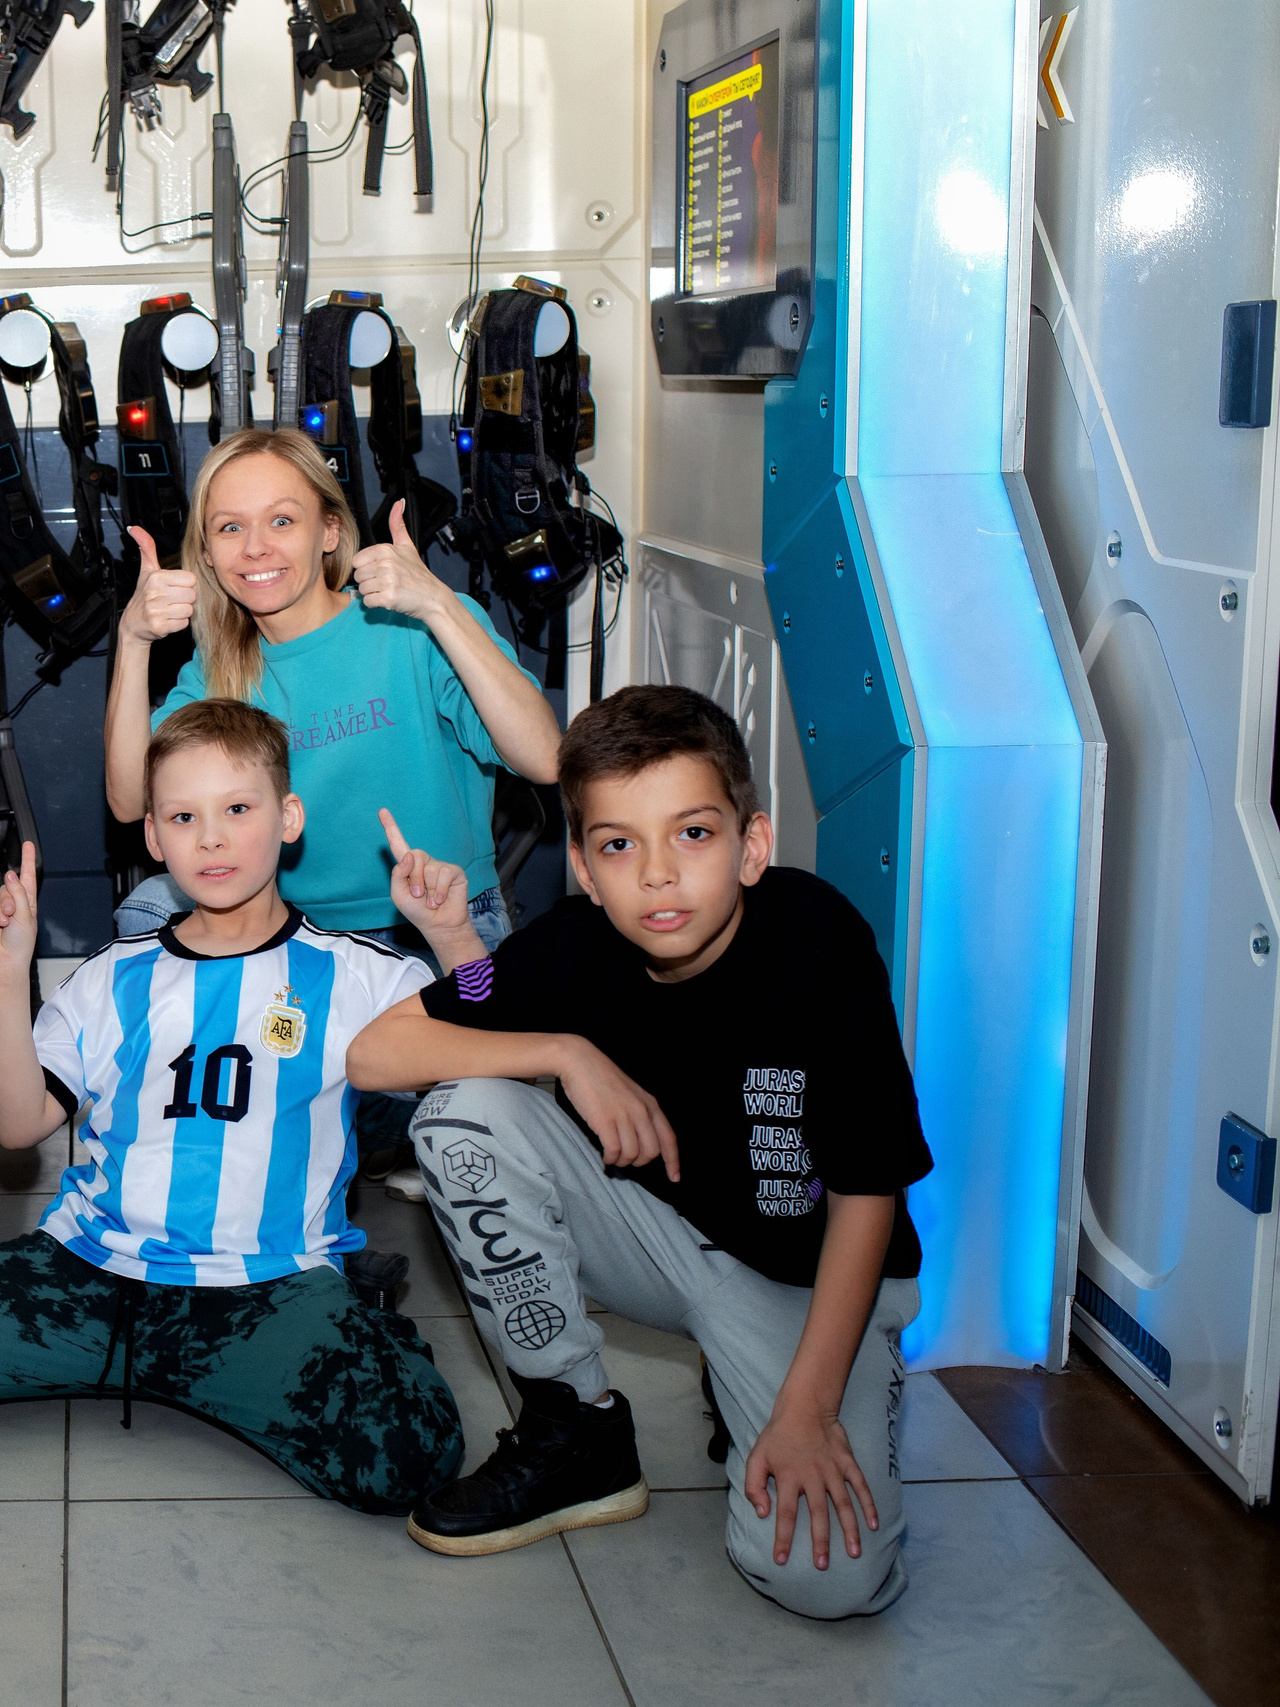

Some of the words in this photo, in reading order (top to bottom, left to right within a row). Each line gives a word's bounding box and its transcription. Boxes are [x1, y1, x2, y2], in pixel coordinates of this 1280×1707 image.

[138, 453, 151, 468] 11
[287, 697, 396, 752] REAMER
[311, 704, 355, 725] TIME
[271, 1016, 292, 1041] AFA
[163, 1043, 254, 1122] 10
[743, 1068, 806, 1093] JURAS
[743, 1093, 804, 1118] WORL
[484, 1262, 548, 1286] SUPER
[493, 1276, 546, 1296] COOL
[493, 1281, 551, 1305] TODAY
